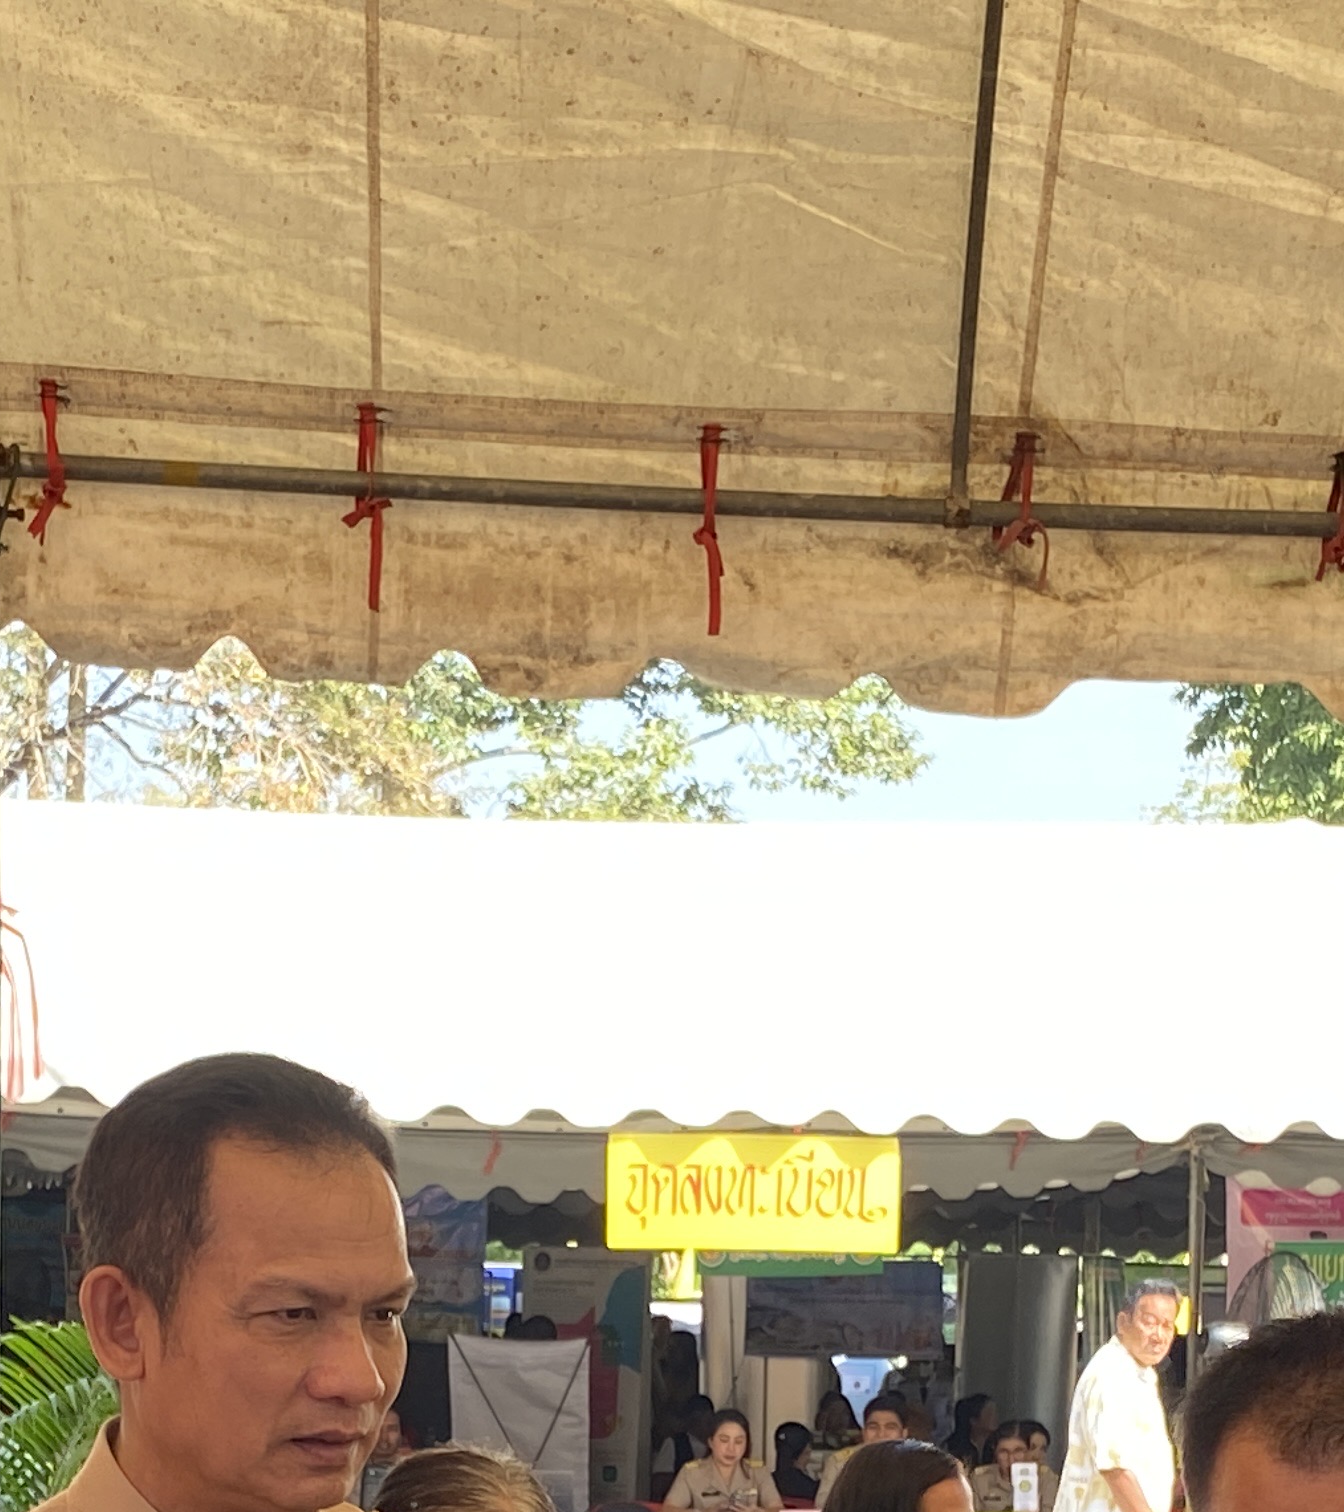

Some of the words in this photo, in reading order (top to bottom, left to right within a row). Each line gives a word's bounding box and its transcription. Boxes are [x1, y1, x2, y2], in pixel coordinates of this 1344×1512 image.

[625, 1150, 888, 1230] จุดลงทะเบียน
